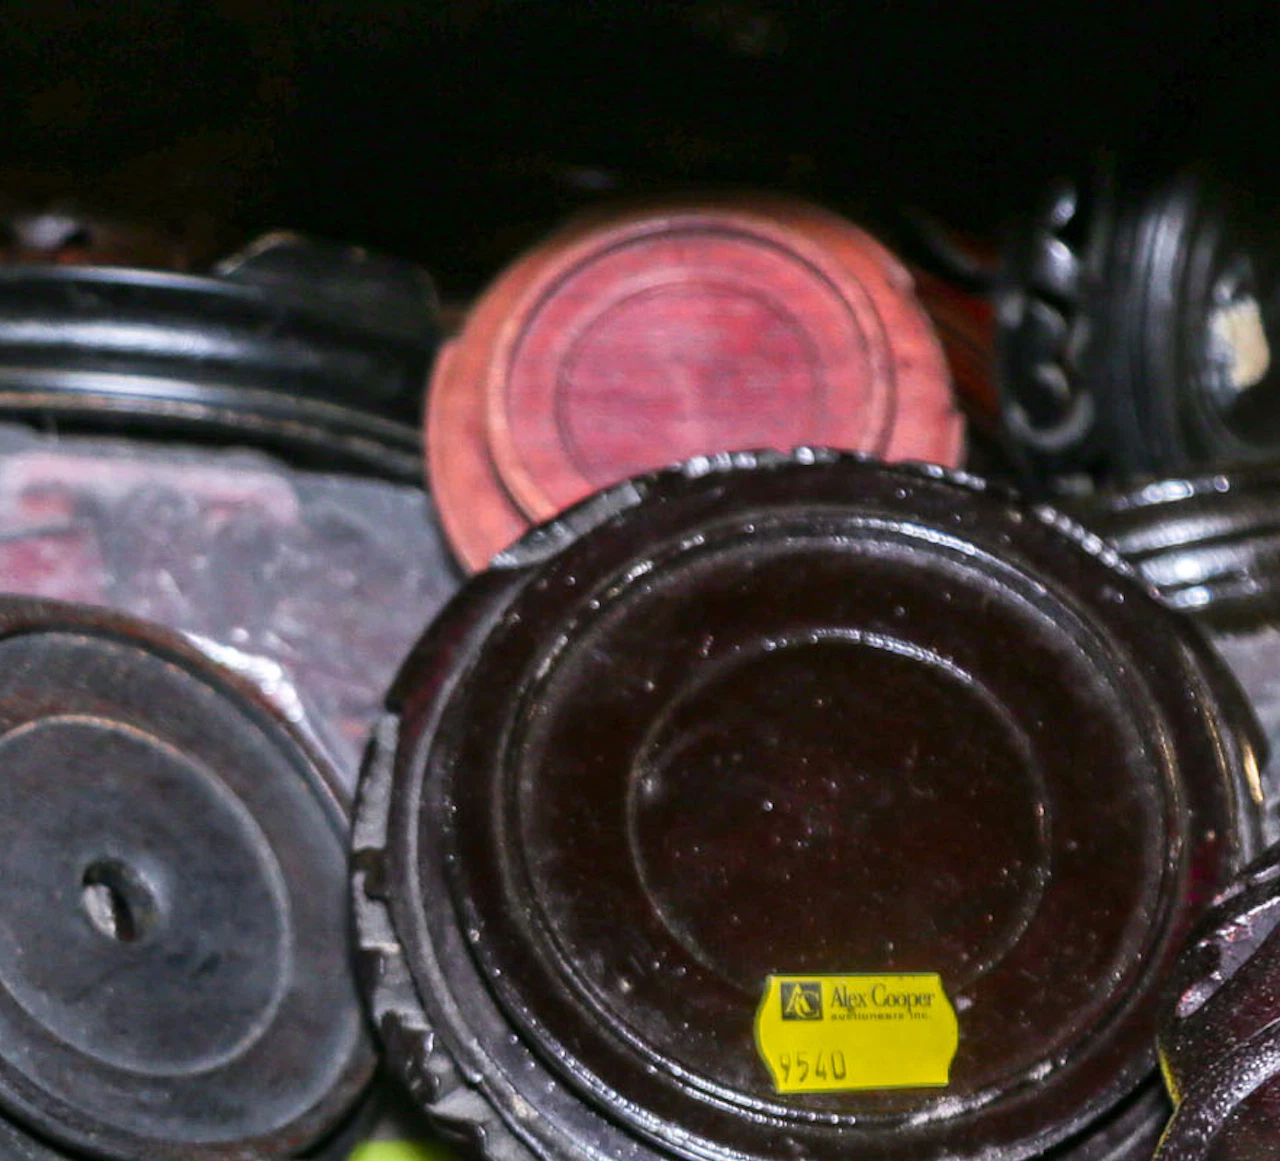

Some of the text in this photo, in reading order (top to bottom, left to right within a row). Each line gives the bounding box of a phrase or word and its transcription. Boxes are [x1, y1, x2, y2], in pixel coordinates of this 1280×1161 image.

[830, 983, 936, 1014] Alex Cooper
[779, 1050, 847, 1083] 9540
